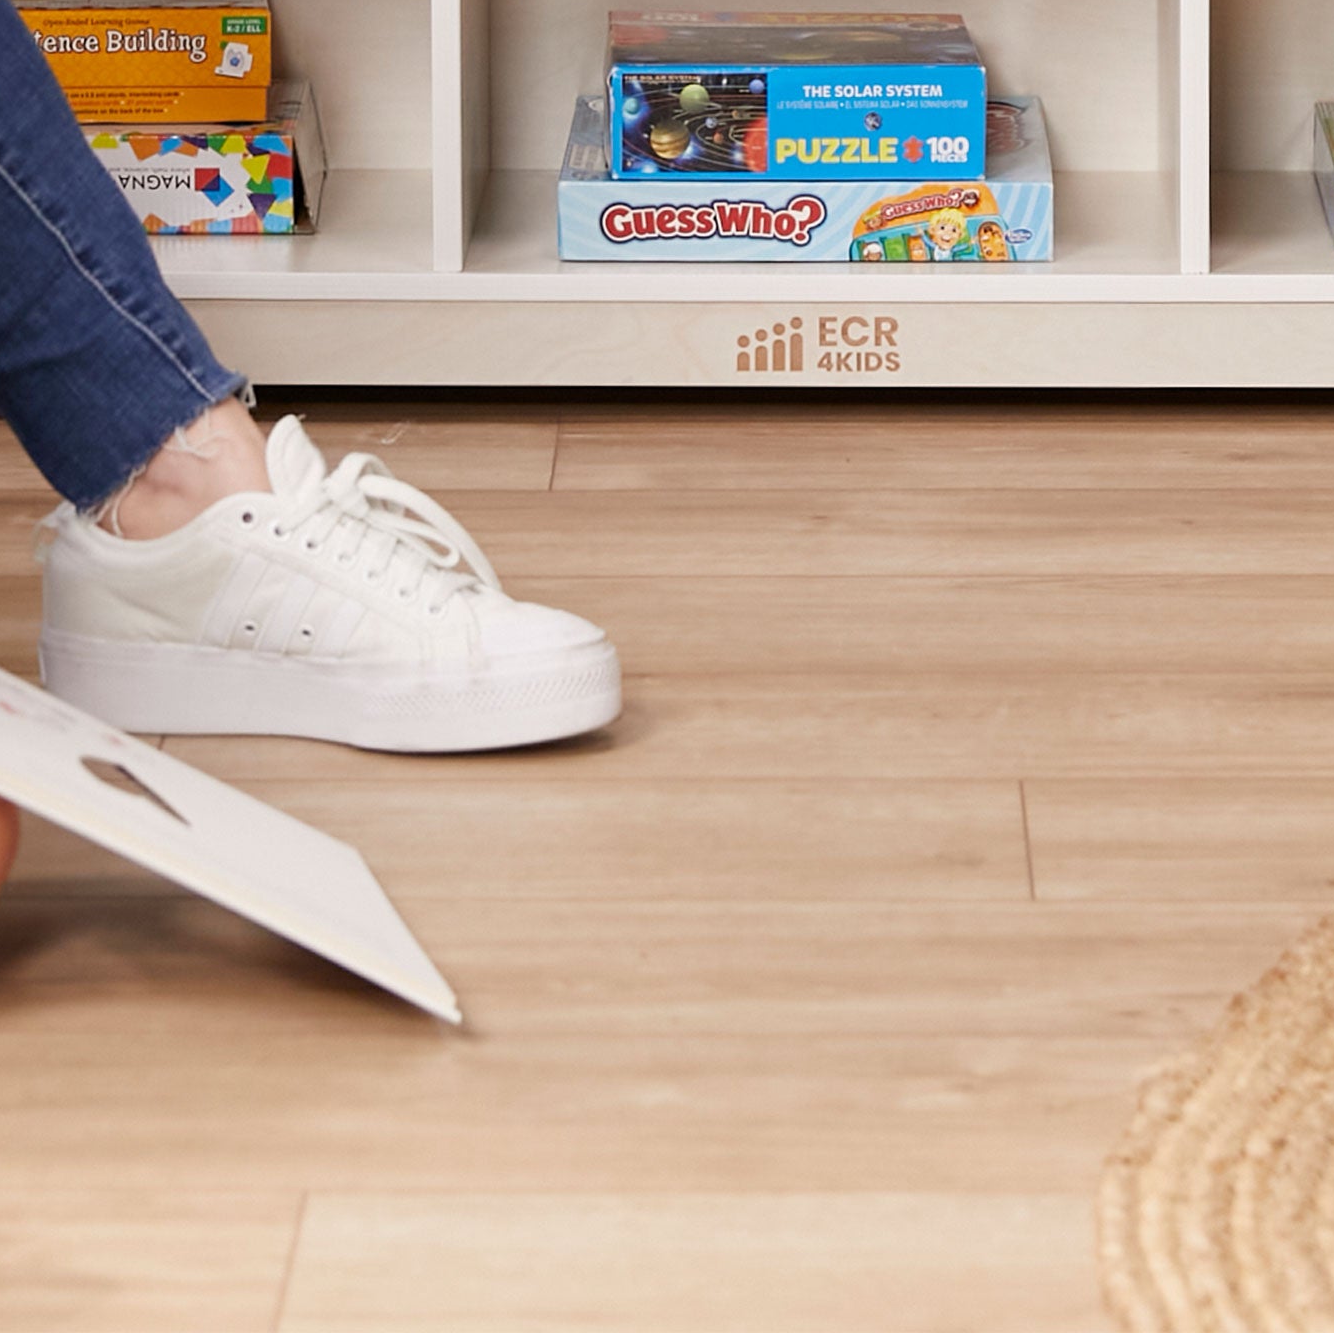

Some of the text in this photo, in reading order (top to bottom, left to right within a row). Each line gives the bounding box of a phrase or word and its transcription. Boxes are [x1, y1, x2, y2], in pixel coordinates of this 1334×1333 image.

[91, 18, 123, 28] Learning
[247, 25, 261, 33] ELL
[33, 28, 207, 63] tence Building
[803, 85, 943, 97] THE SOLAR SYSTEM
[775, 136, 969, 164] PUZZLE 100
[930, 153, 968, 163] PIECES
[118, 174, 191, 190] MAGNA
[882, 188, 963, 219] Guess Who?
[603, 196, 824, 244] Guess Who?
[818, 316, 899, 347] ECR
[817, 351, 901, 372] 4KIDS
